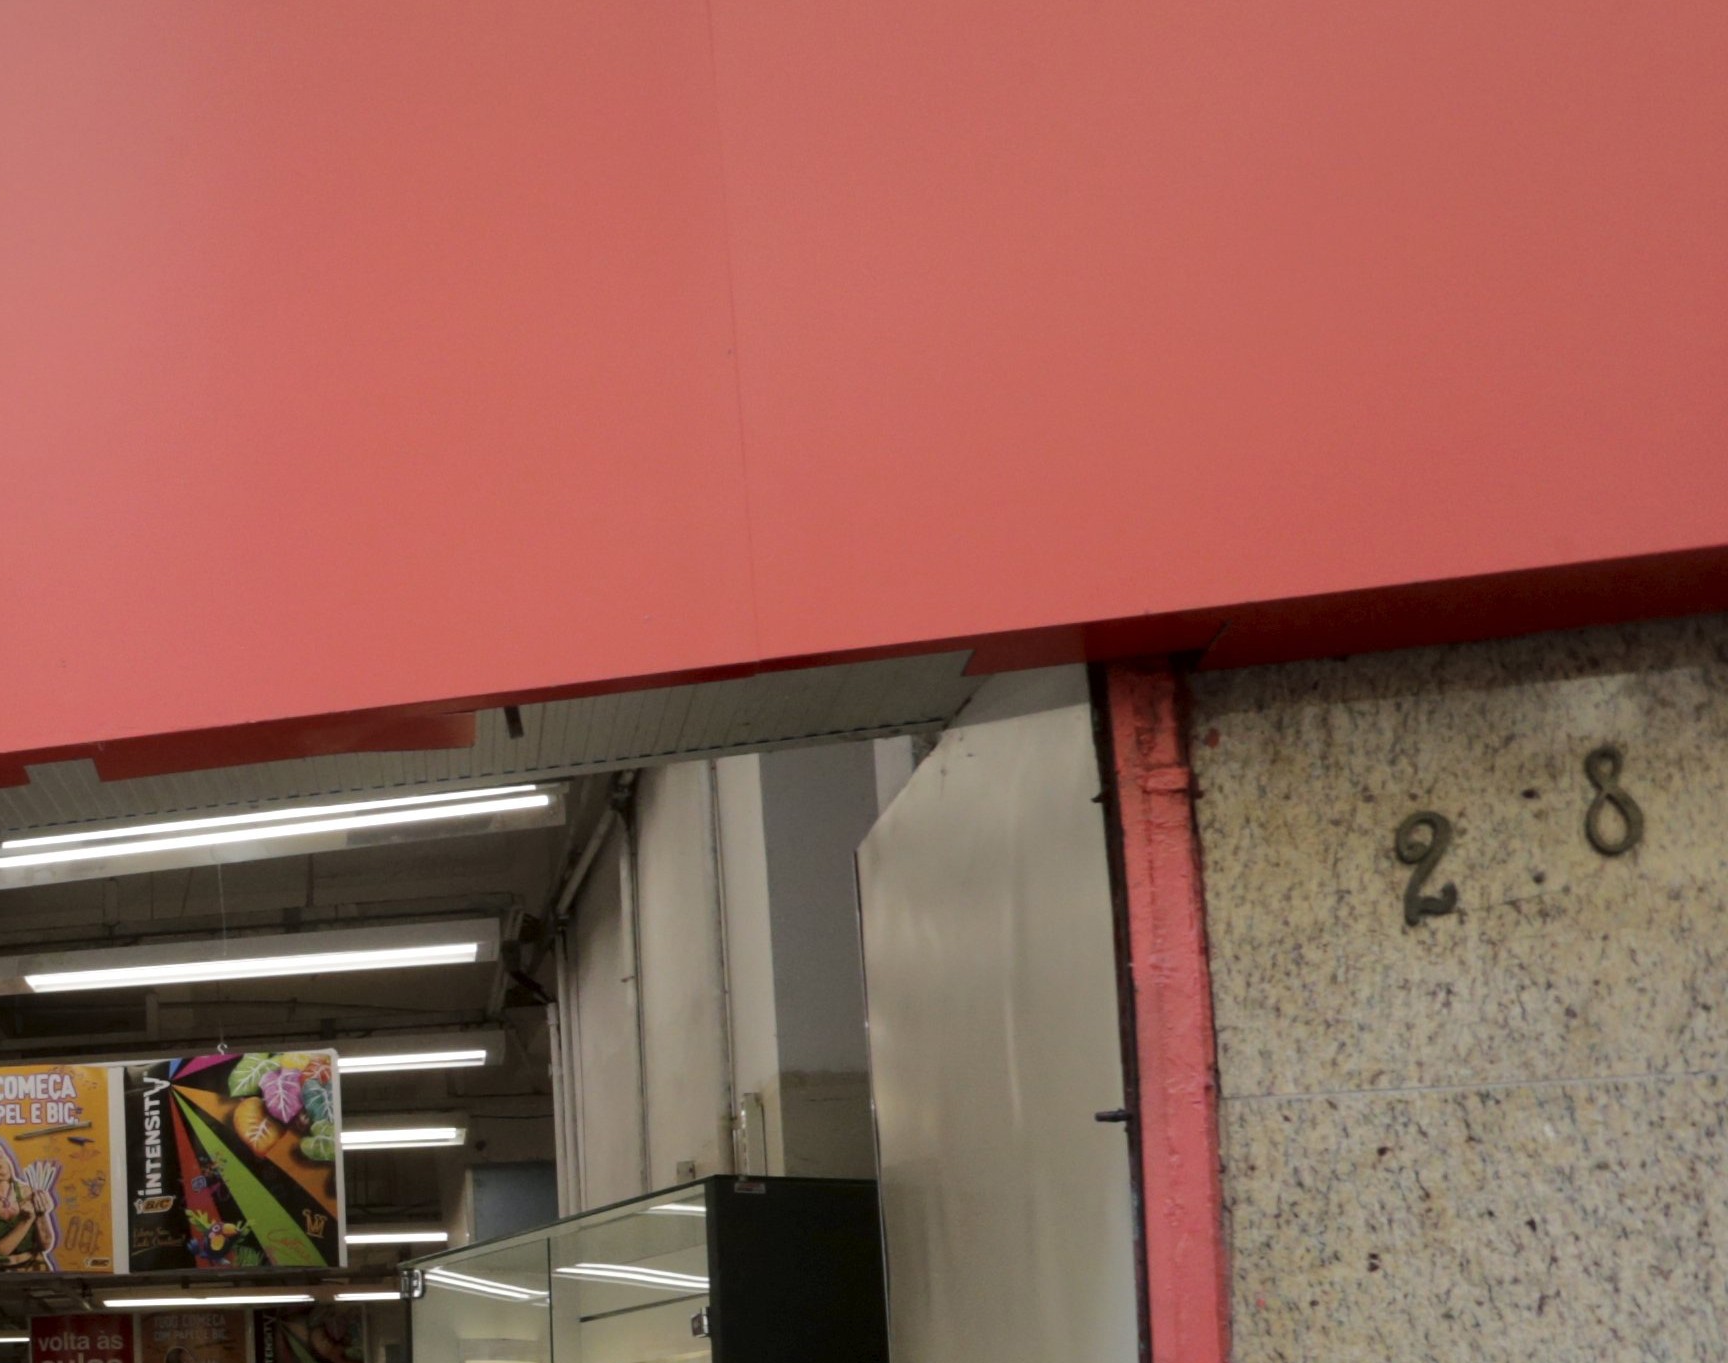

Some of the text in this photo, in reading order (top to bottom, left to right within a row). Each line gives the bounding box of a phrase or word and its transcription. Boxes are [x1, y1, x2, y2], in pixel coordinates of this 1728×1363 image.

[31, 1104, 41, 1124] E
[39, 1330, 124, 1351] volta às
